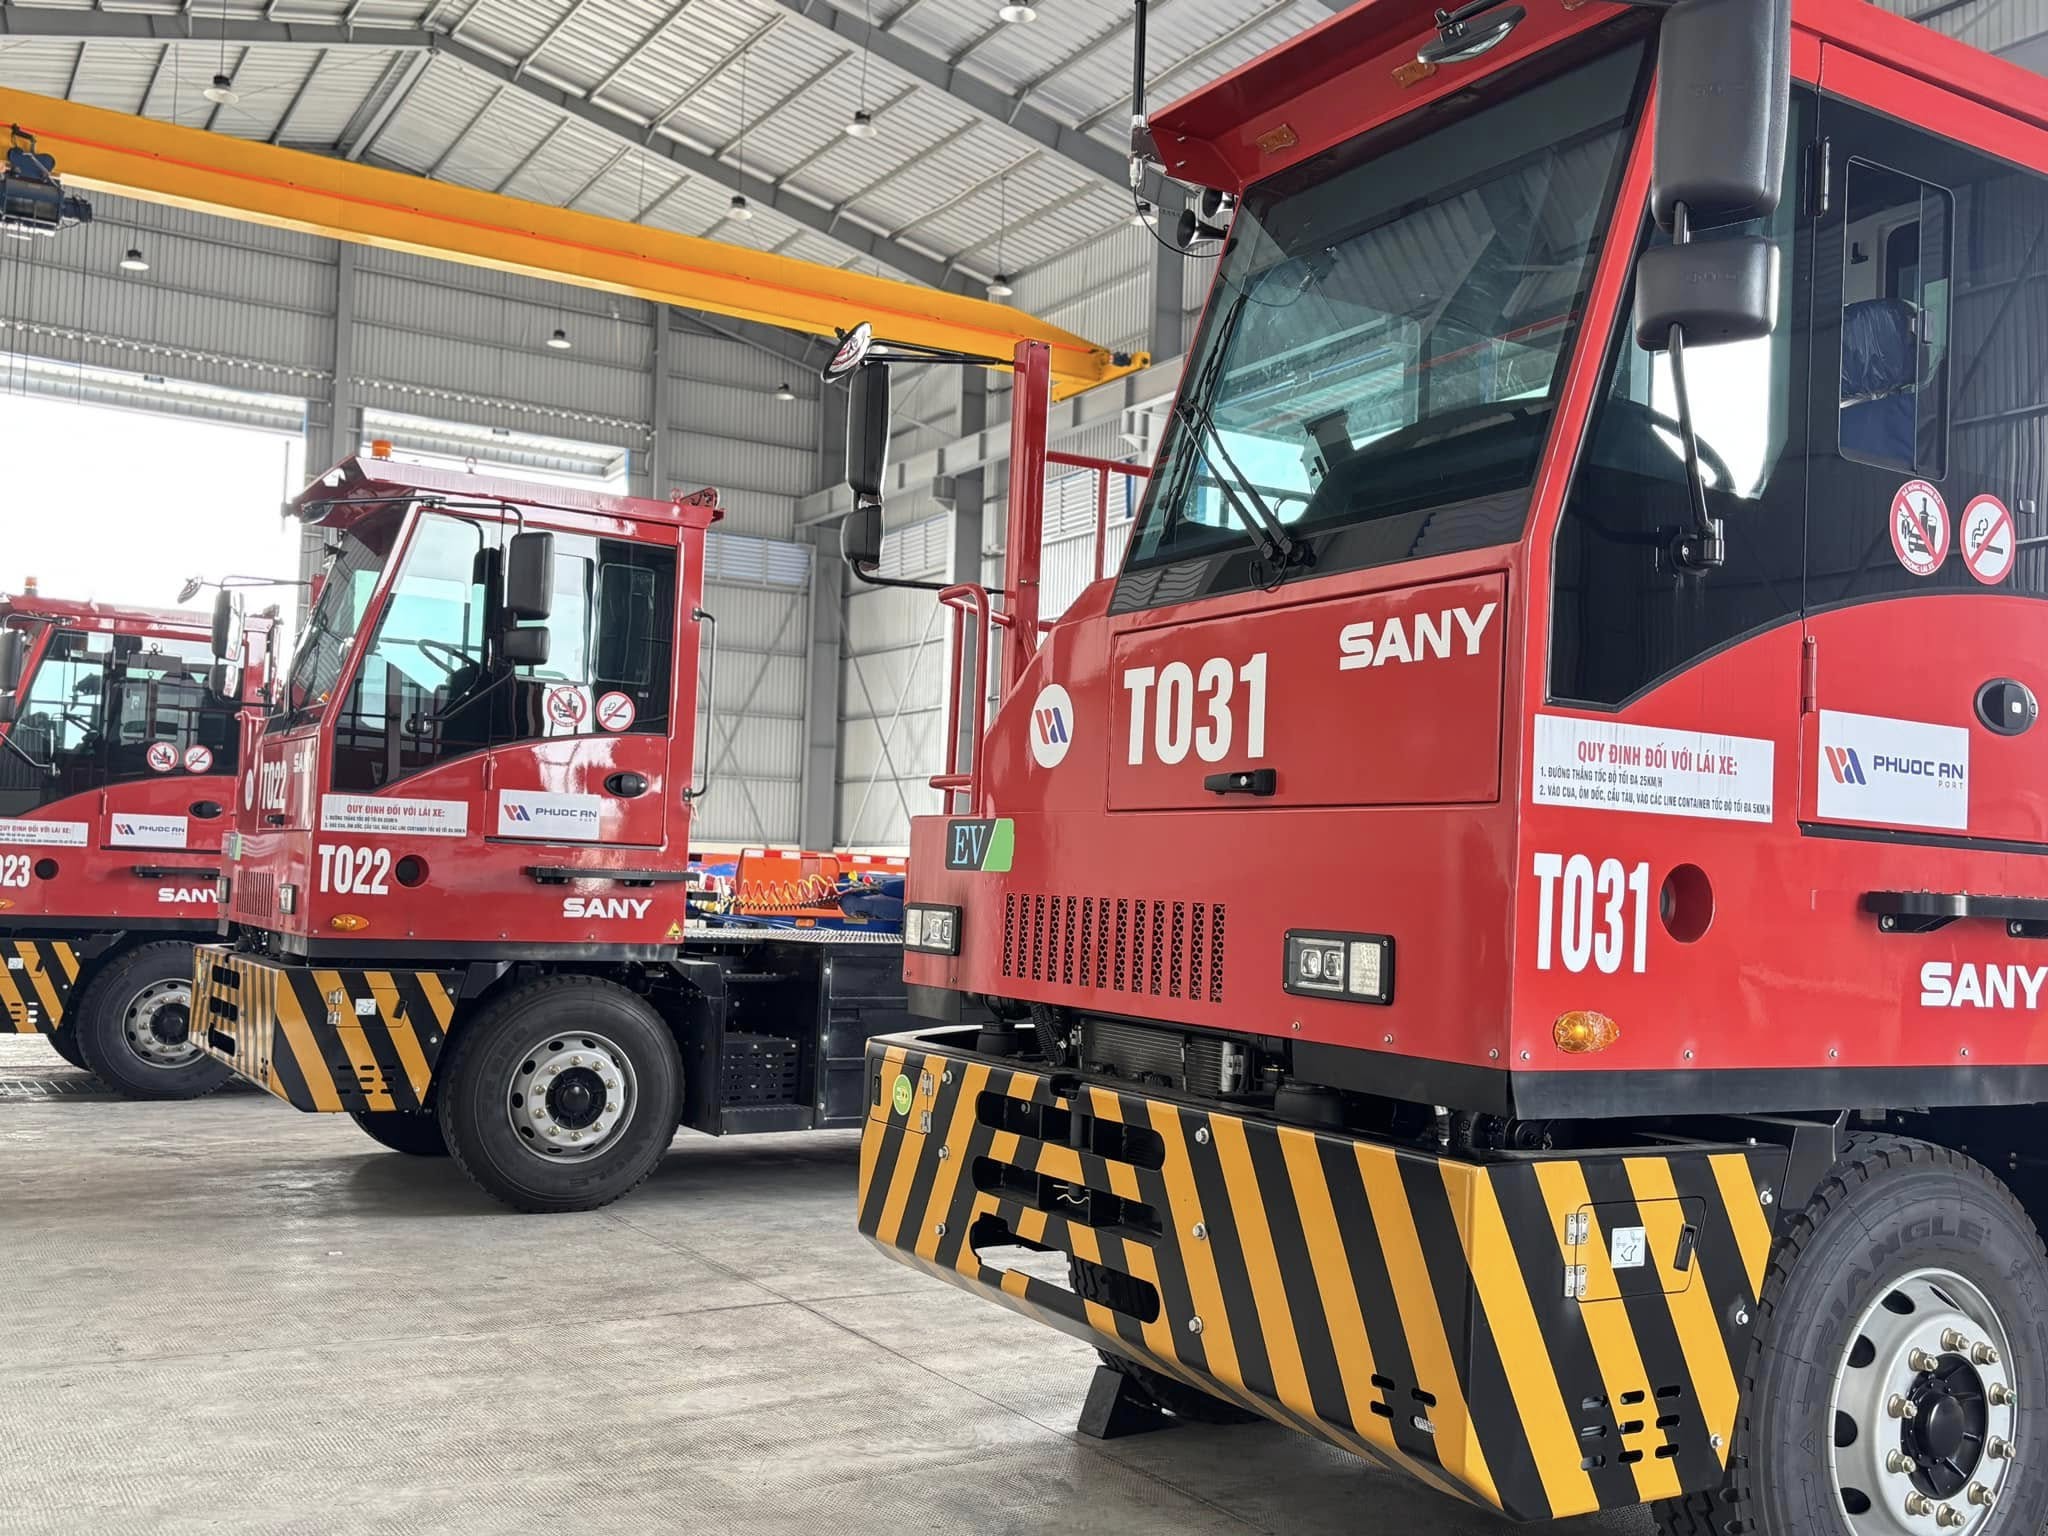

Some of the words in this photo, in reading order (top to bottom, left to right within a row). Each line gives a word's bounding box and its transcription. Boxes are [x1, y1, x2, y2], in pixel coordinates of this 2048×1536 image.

[1339, 602, 1497, 671] SANY
[1124, 652, 1267, 765] T031
[1540, 766, 1547, 778] 1.
[1578, 741, 1605, 763] QUY
[1609, 744, 1641, 769] ĐỊNH
[1645, 742, 1667, 769] ĐỐI
[1671, 747, 1692, 771] VỚI
[1696, 749, 1715, 774] LÁI
[1719, 755, 1737, 776] XE:
[1873, 755, 1935, 777] PHUOC
[1938, 762, 1964, 779] AN
[1539, 784, 1546, 796] 2.
[1938, 780, 1963, 790] PORT
[535, 807, 578, 817] PHUOC
[580, 810, 597, 818] AN
[952, 826, 987, 864] EV
[318, 844, 391, 895] T022
[563, 898, 652, 919] SANY
[1533, 852, 1649, 973] T031
[1920, 962, 2048, 1009] SANY
